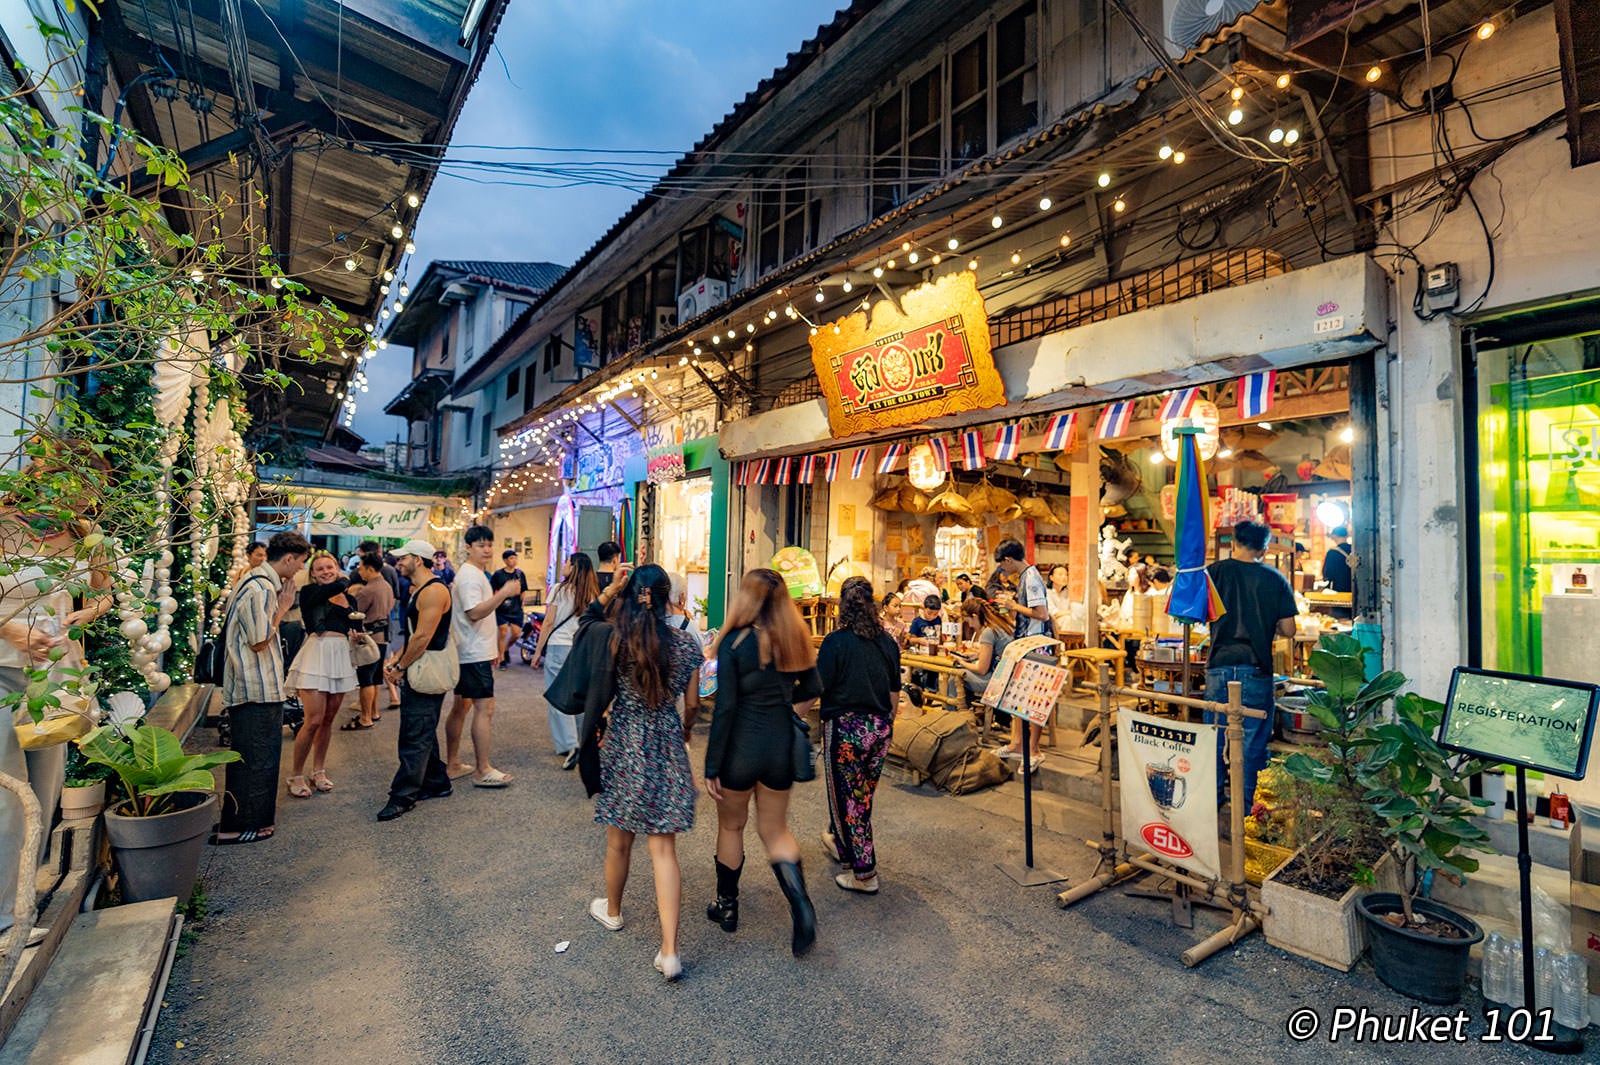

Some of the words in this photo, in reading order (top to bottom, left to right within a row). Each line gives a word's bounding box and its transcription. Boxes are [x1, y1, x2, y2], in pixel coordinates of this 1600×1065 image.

[1317, 319, 1340, 331] 1212
[884, 398, 896, 407] THE
[898, 394, 913, 403] OLD
[915, 388, 937, 400] TOWN
[1457, 702, 1578, 732] REGISTERATION
[1134, 734, 1159, 748] Black
[1162, 740, 1191, 754] Coffee
